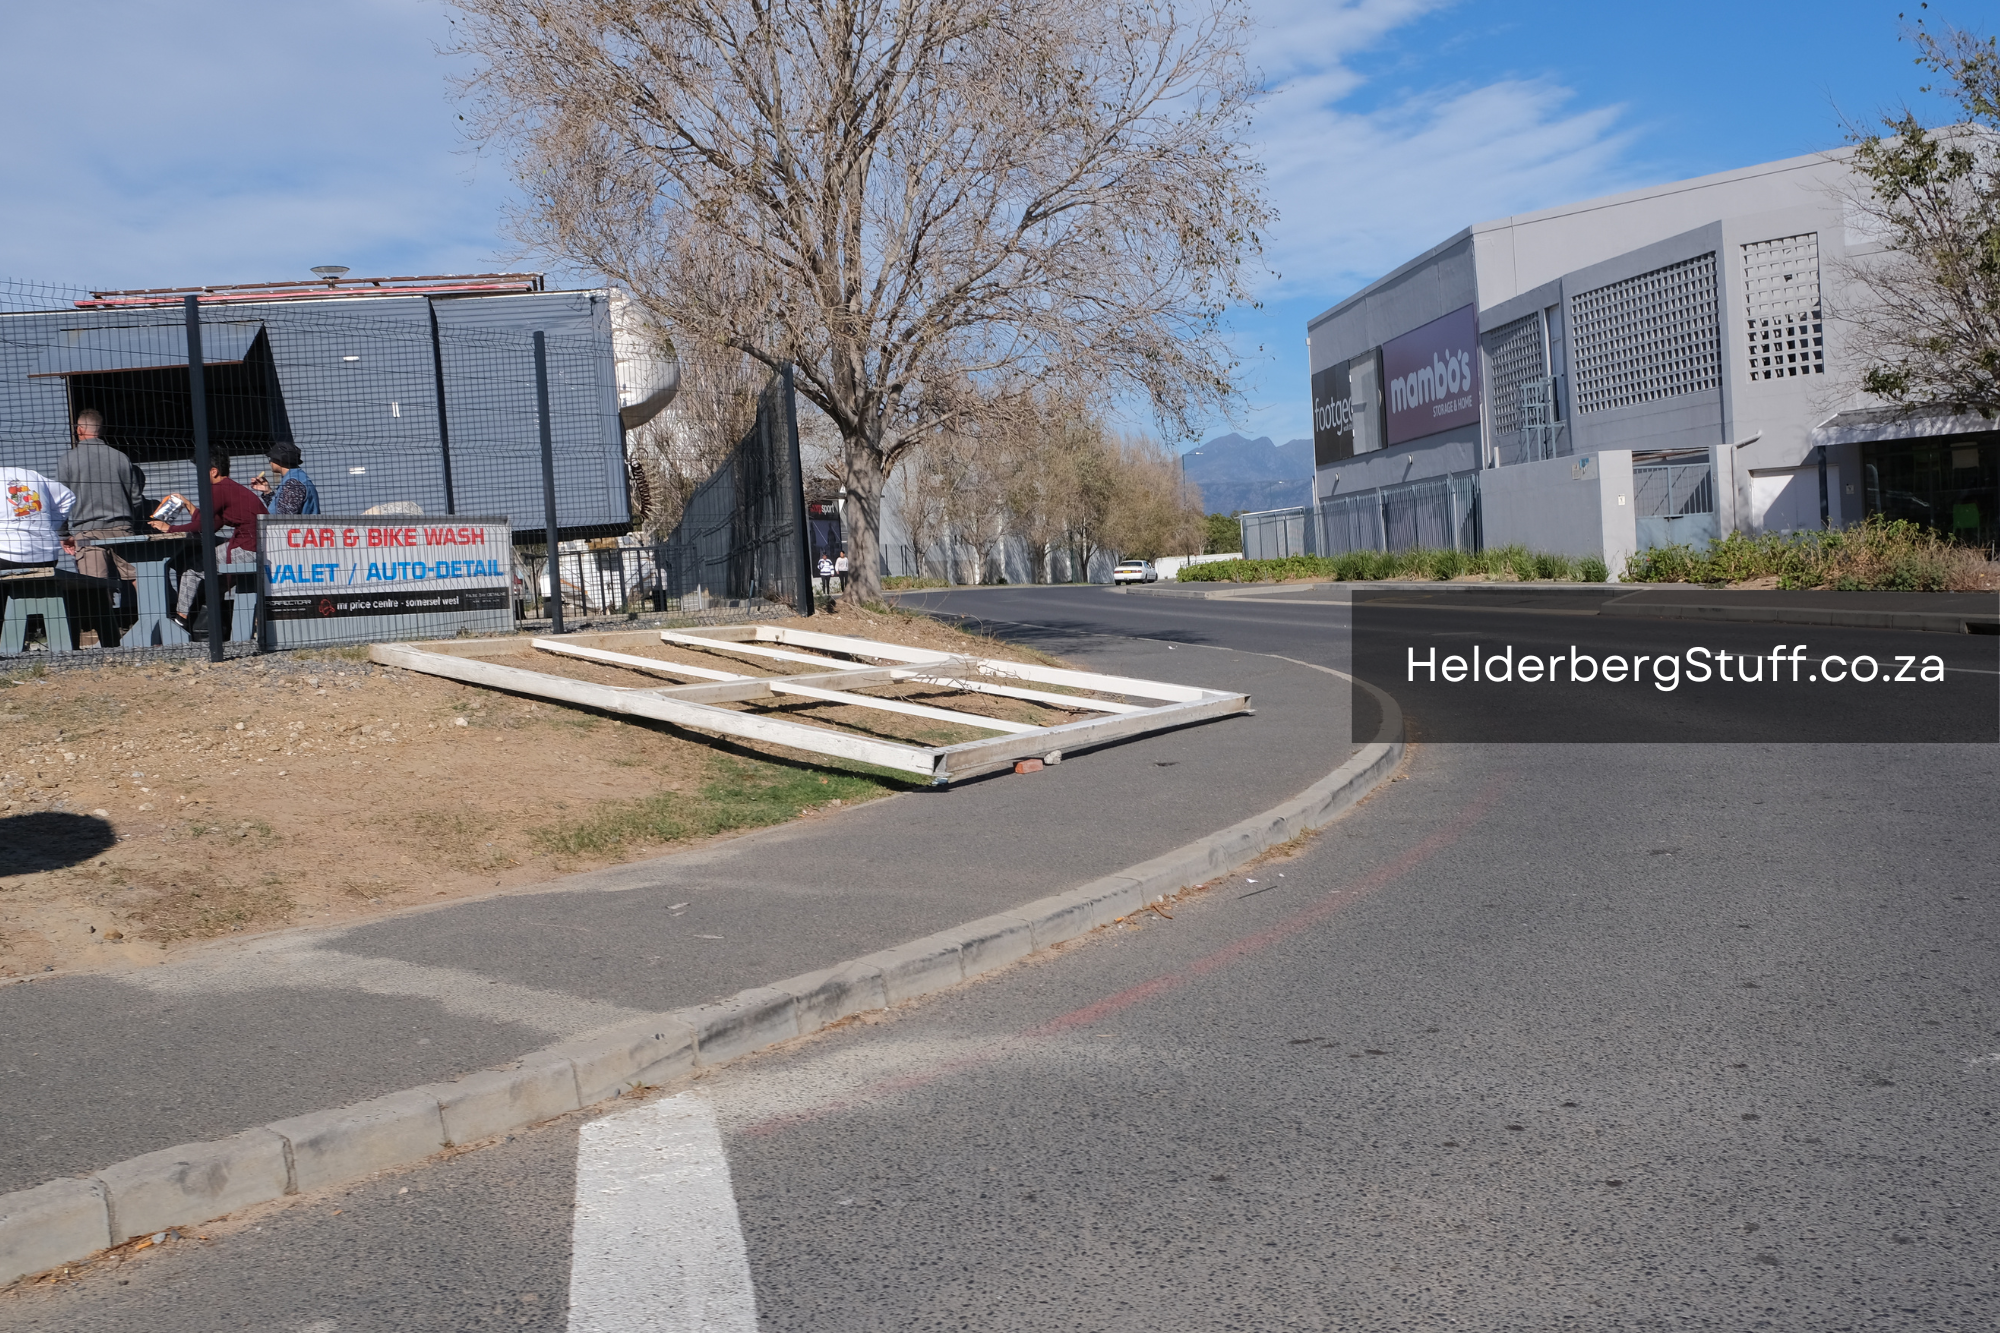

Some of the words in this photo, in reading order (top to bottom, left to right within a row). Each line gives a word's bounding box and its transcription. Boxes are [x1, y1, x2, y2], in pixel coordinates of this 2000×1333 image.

[1432, 400, 1454, 418] STORAGE
[1453, 399, 1458, 412] &
[1457, 395, 1473, 411] HOME
[287, 528, 335, 548] CAR
[343, 528, 359, 547] &
[367, 528, 417, 547] BIKE
[424, 527, 485, 546] WASH
[264, 563, 339, 584] VALET
[347, 562, 357, 586] /
[366, 559, 504, 581] AUTO-DETAIL
[336, 602, 348, 610] mr
[350, 599, 371, 611] price
[372, 598, 399, 609] centre
[405, 596, 440, 607] somerset
[442, 595, 459, 605] west
